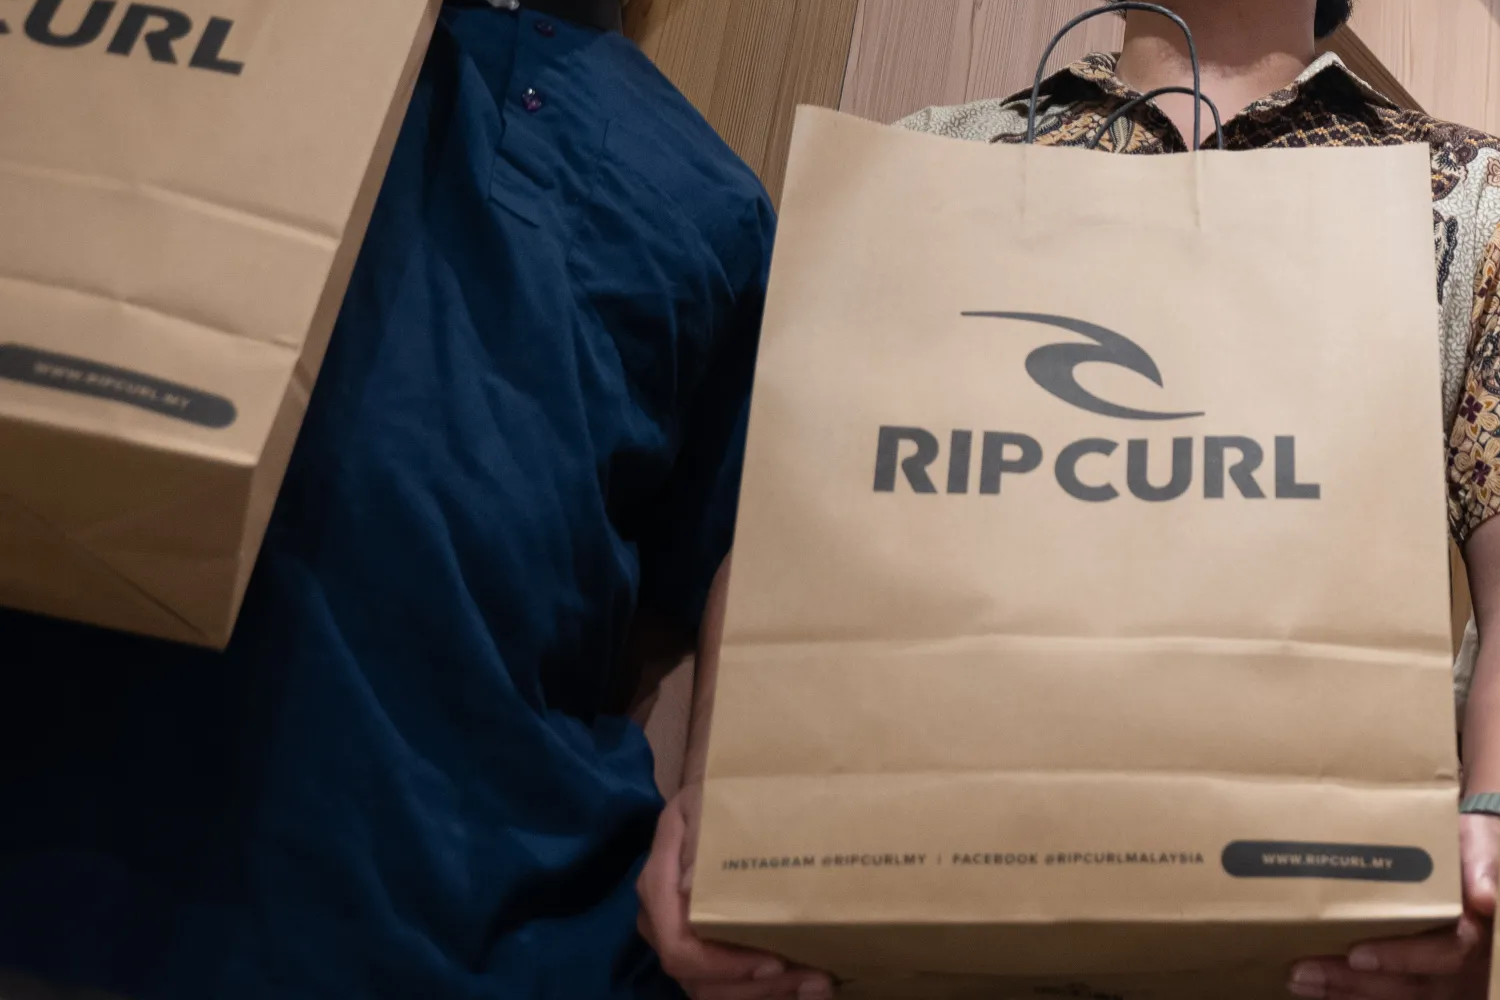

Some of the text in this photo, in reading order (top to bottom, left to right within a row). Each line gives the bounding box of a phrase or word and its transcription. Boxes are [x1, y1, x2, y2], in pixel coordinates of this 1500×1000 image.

[722, 855, 815, 871] INSTAGRAM
[951, 852, 1039, 866] FACEBOOK
[1261, 852, 1394, 870] WWW.RIPCURL.MY
